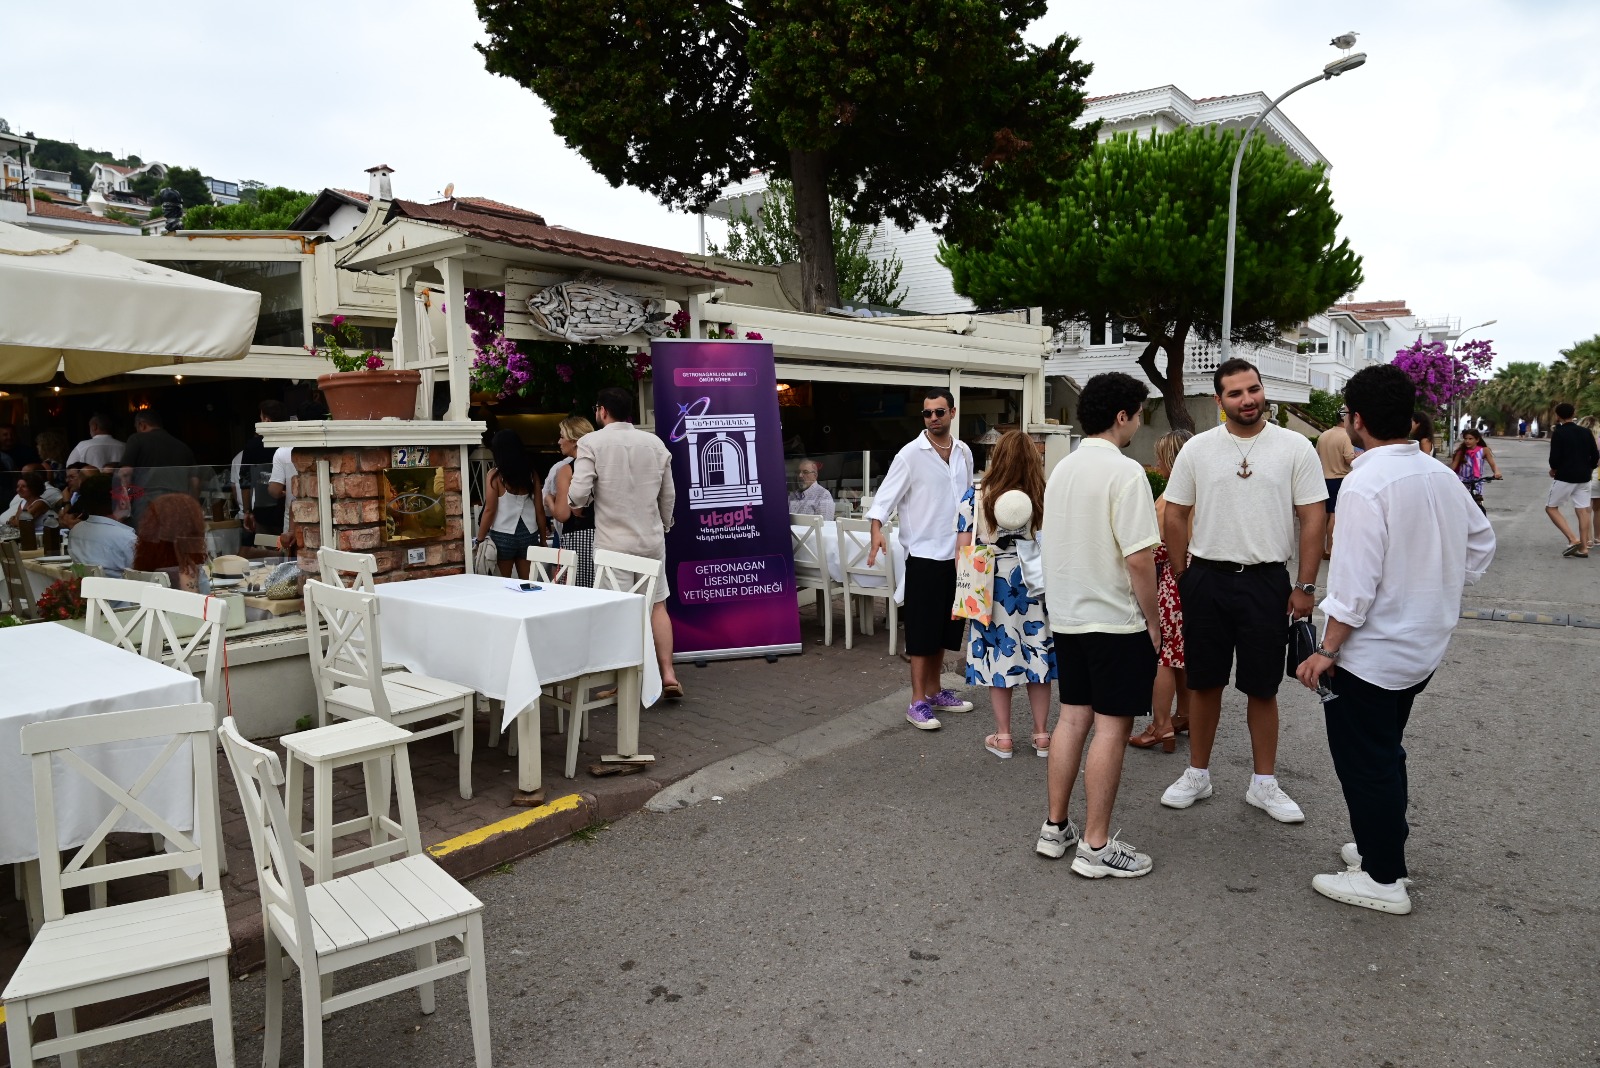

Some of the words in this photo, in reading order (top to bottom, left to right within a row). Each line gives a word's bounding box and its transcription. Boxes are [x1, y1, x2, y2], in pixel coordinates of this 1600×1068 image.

[695, 560, 765, 575] GETRONAGAN
[704, 573, 759, 587] LİSESİNDEN
[683, 587, 738, 602] YETİŞENLER
[740, 581, 783, 596] DERNEĞİ
